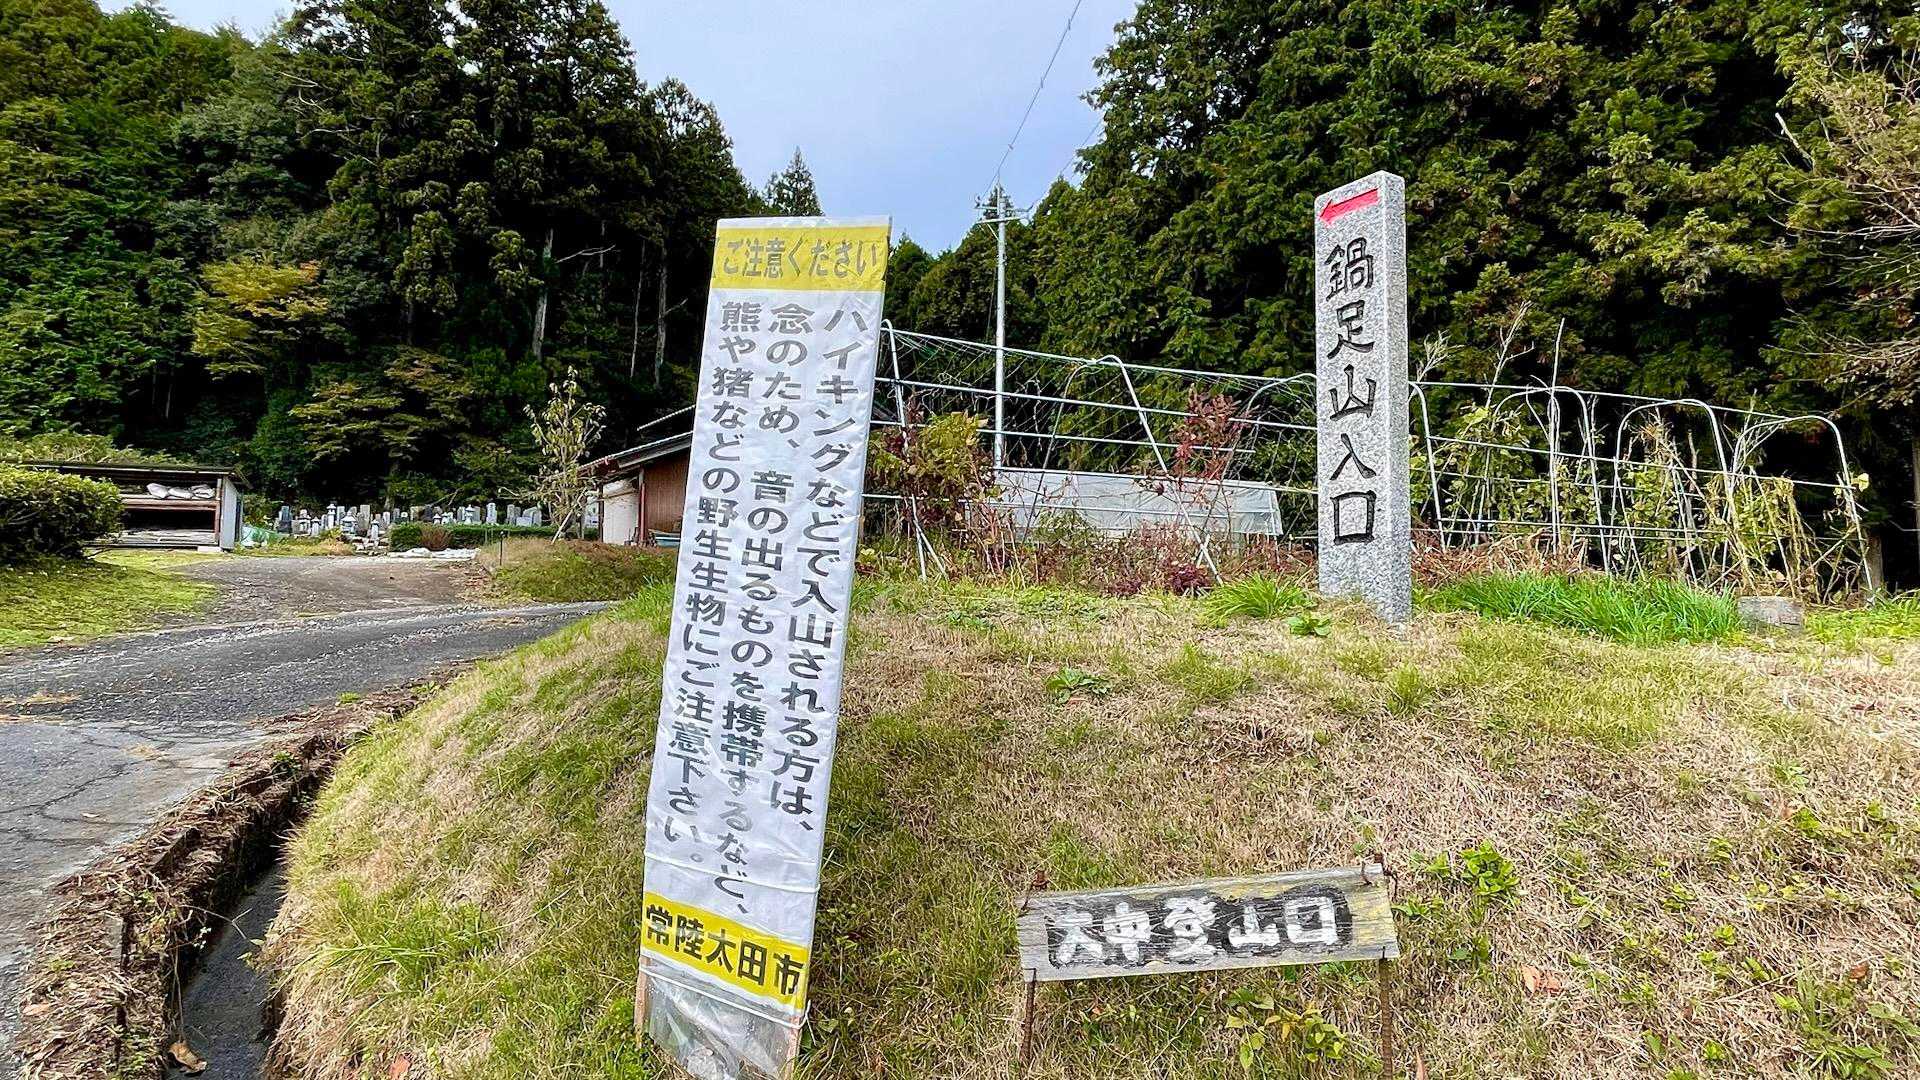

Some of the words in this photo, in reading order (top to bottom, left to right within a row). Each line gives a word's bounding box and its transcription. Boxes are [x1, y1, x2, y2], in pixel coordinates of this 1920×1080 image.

[723, 236, 878, 279] ご注意ください
[1324, 236, 1377, 546] 鍋足山入口
[664, 301, 761, 862] 熊や猪などの野生生物にご注意下さい。
[714, 303, 815, 914] 念のため、音の出るものを携帯するなど、
[770, 309, 869, 832] ハイキングなどで入山される方は、
[645, 903, 806, 996] 常陸太田市
